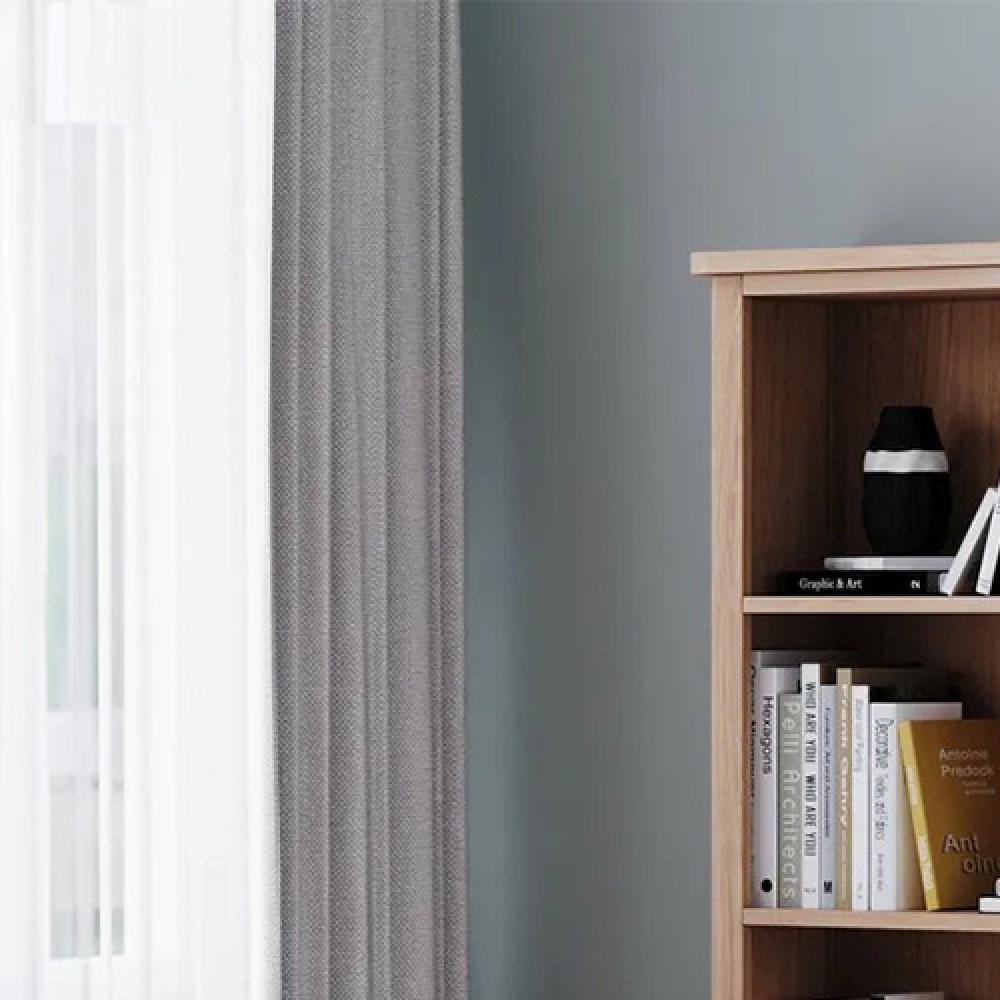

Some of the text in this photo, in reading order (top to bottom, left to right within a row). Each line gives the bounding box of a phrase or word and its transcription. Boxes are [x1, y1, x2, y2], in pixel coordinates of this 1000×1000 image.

[799, 577, 834, 592] Graphic
[846, 577, 863, 589] Art
[760, 696, 775, 775] Hexagons
[805, 682, 817, 857] WHO ARE YOU WHO ARE YOU
[782, 701, 801, 900] Pelli Architects
